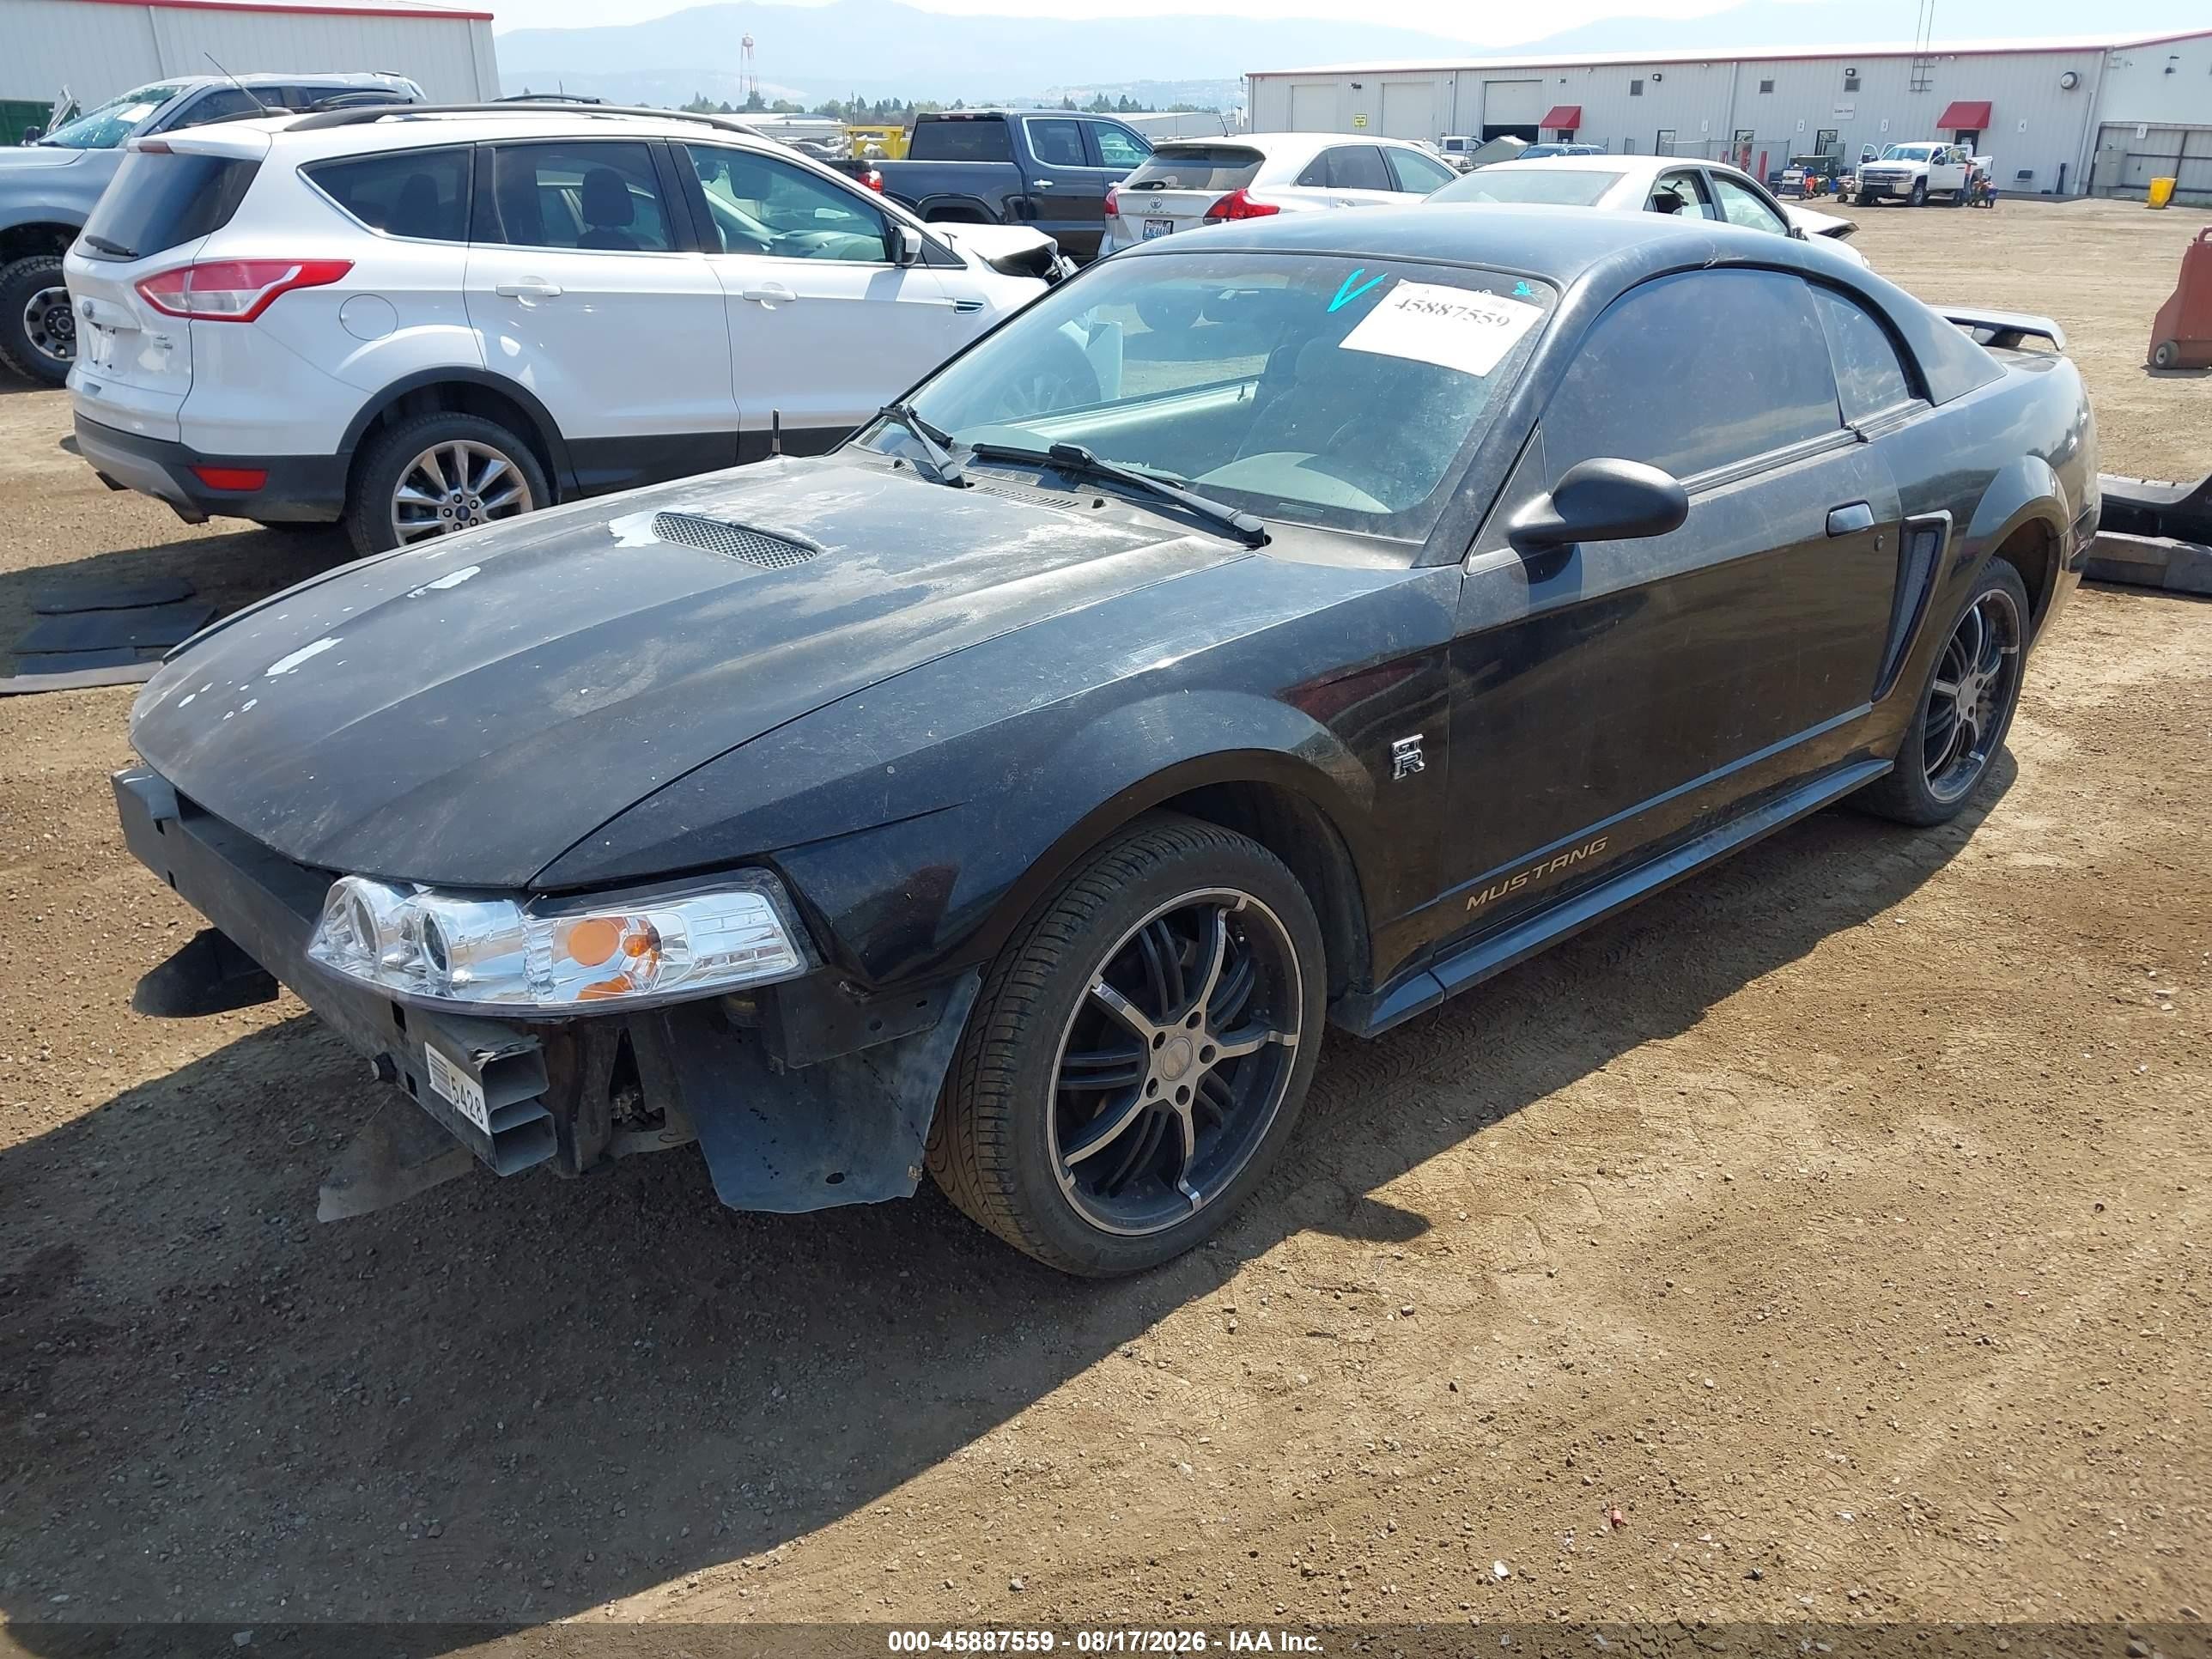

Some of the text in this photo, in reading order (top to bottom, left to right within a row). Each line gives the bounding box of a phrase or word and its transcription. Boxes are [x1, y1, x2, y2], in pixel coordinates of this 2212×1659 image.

[1394, 298, 1510, 327] 45887559
[1466, 836, 1608, 911] MUSTANG
[451, 1075, 483, 1125] 5428
